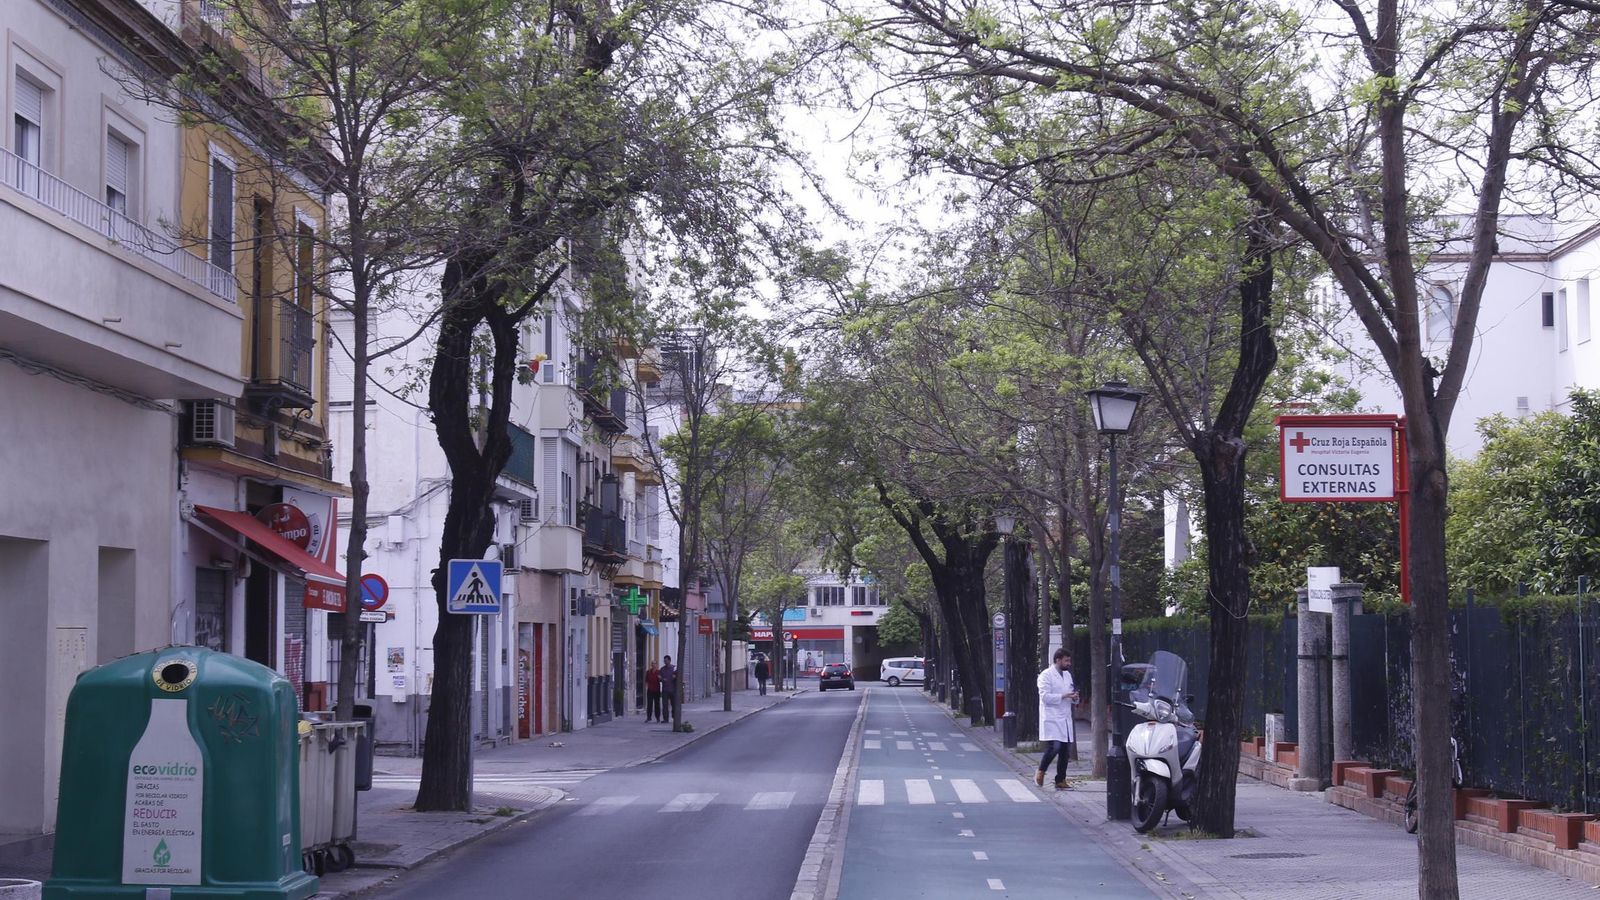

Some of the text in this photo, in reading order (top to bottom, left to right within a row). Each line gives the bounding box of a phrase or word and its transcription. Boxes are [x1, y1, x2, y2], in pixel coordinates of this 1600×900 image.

[1311, 437, 1387, 448] Cruz Roja Española
[1297, 463, 1380, 476] CONSULTAS
[1303, 481, 1376, 493] EXTERNAS
[156, 679, 192, 691] DE VIDRIO
[519, 655, 528, 719] Sandwiches
[133, 762, 197, 776] ecovidrio
[133, 808, 177, 819] REDUCIR
